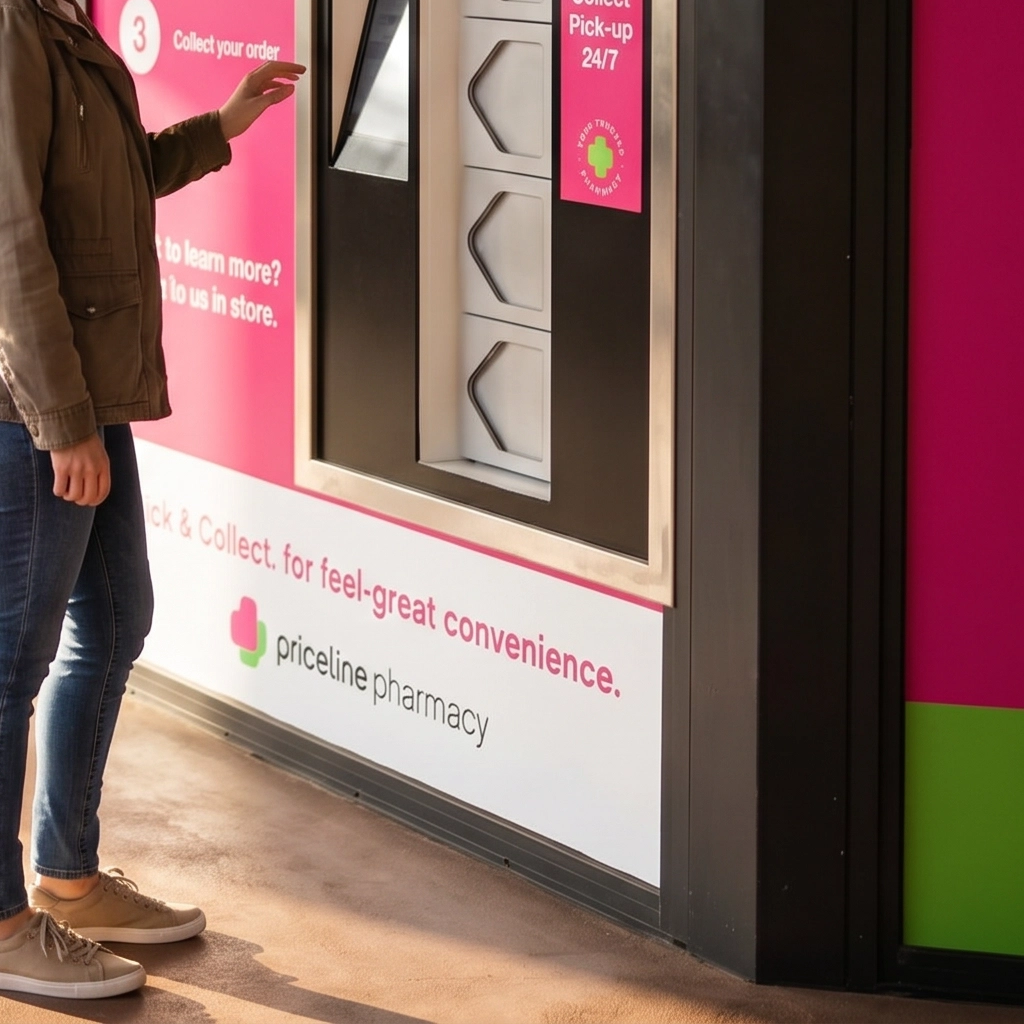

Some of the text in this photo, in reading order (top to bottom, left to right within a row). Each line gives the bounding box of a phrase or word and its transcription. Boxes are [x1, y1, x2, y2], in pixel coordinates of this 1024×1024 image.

[132, 15, 146, 53] 3
[173, 29, 280, 61] Collect your order
[569, 13, 634, 44] Pick-up
[581, 46, 619, 71] 24/7
[164, 236, 182, 264] to
[184, 238, 225, 274] learn
[228, 256, 282, 287] more?
[169, 274, 187, 305] to
[189, 286, 209, 311] us
[212, 284, 227, 316] in
[230, 294, 278, 329] store.
[144, 494, 622, 699] ick & Collect. for feel-great convenience.
[277, 632, 490, 749] priceline pharmacy
